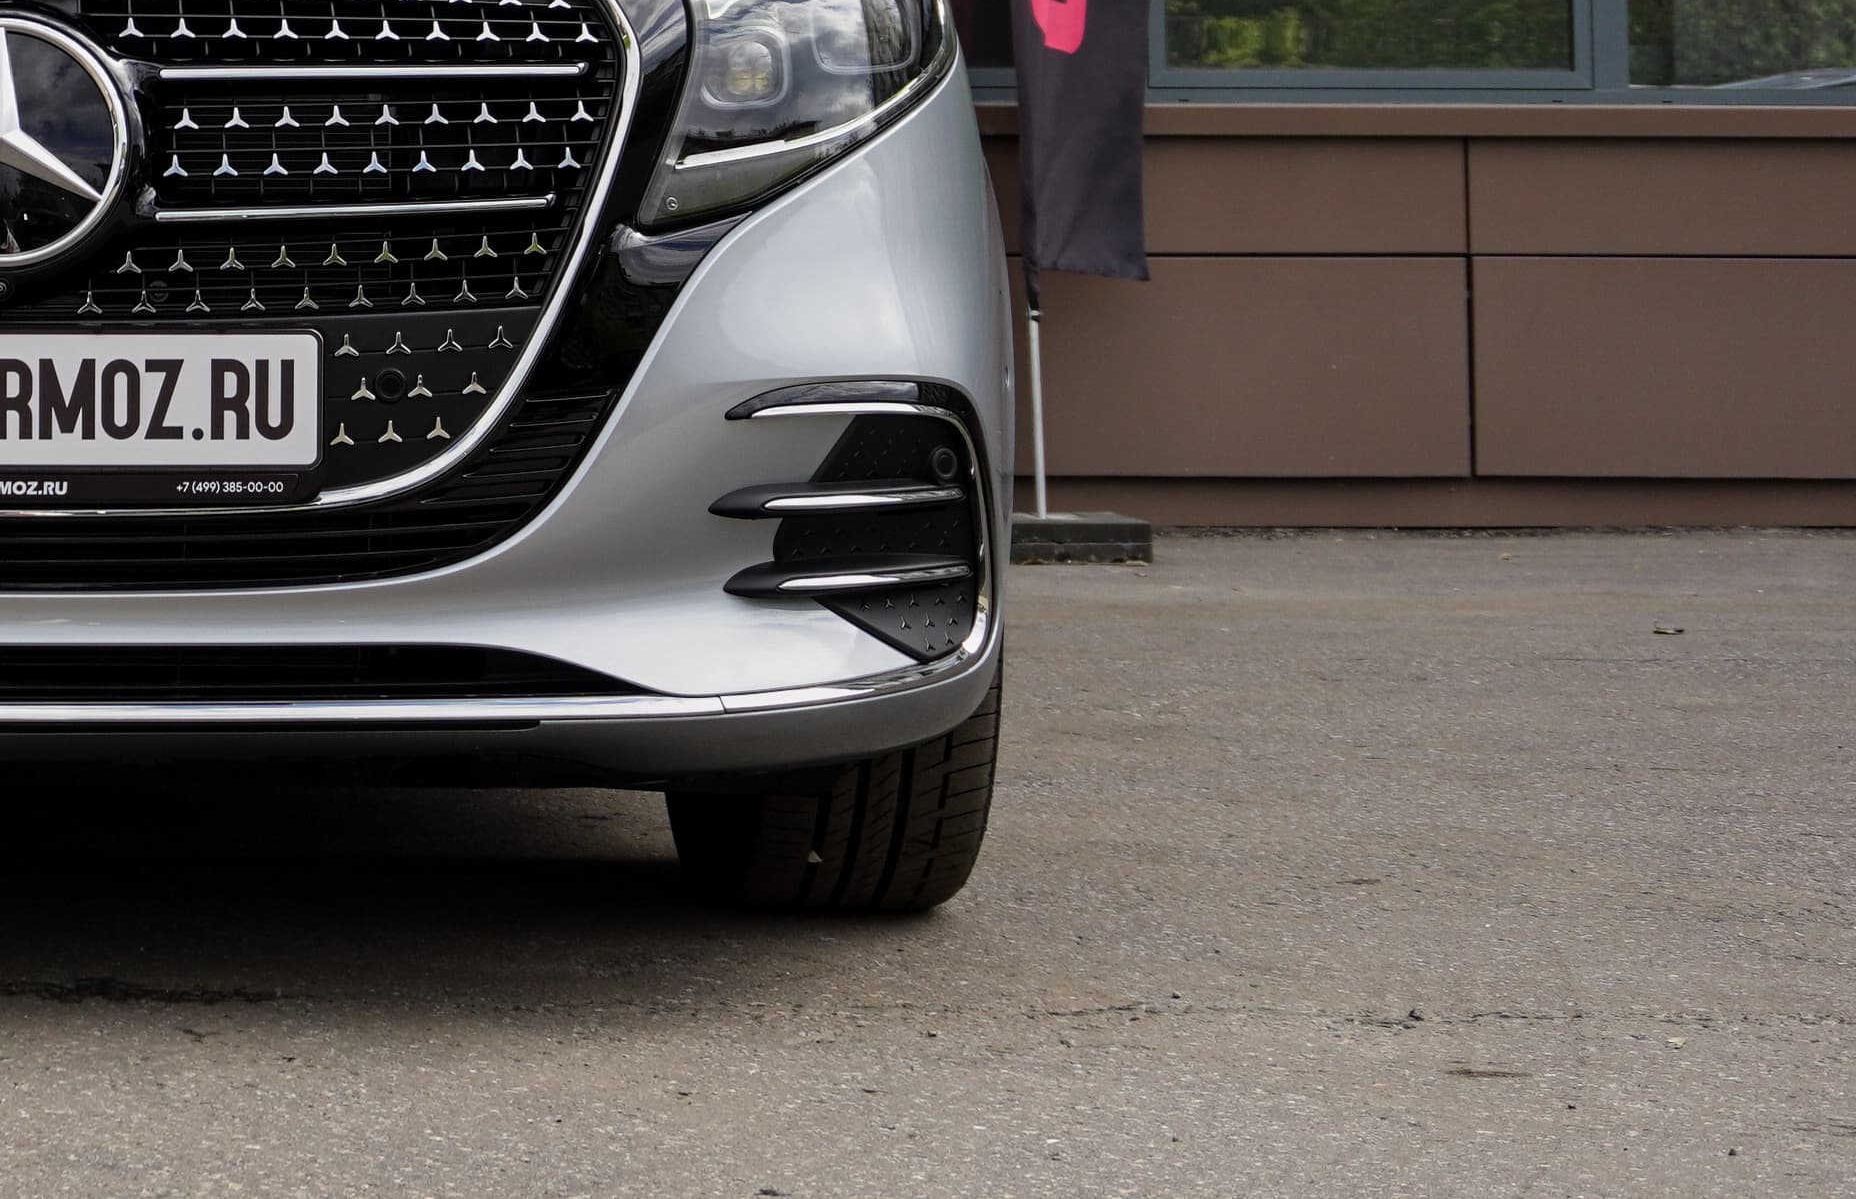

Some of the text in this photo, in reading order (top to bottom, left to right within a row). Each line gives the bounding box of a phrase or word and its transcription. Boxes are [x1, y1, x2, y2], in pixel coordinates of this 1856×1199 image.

[176, 481, 284, 494] +7 (499) 385-00-00
